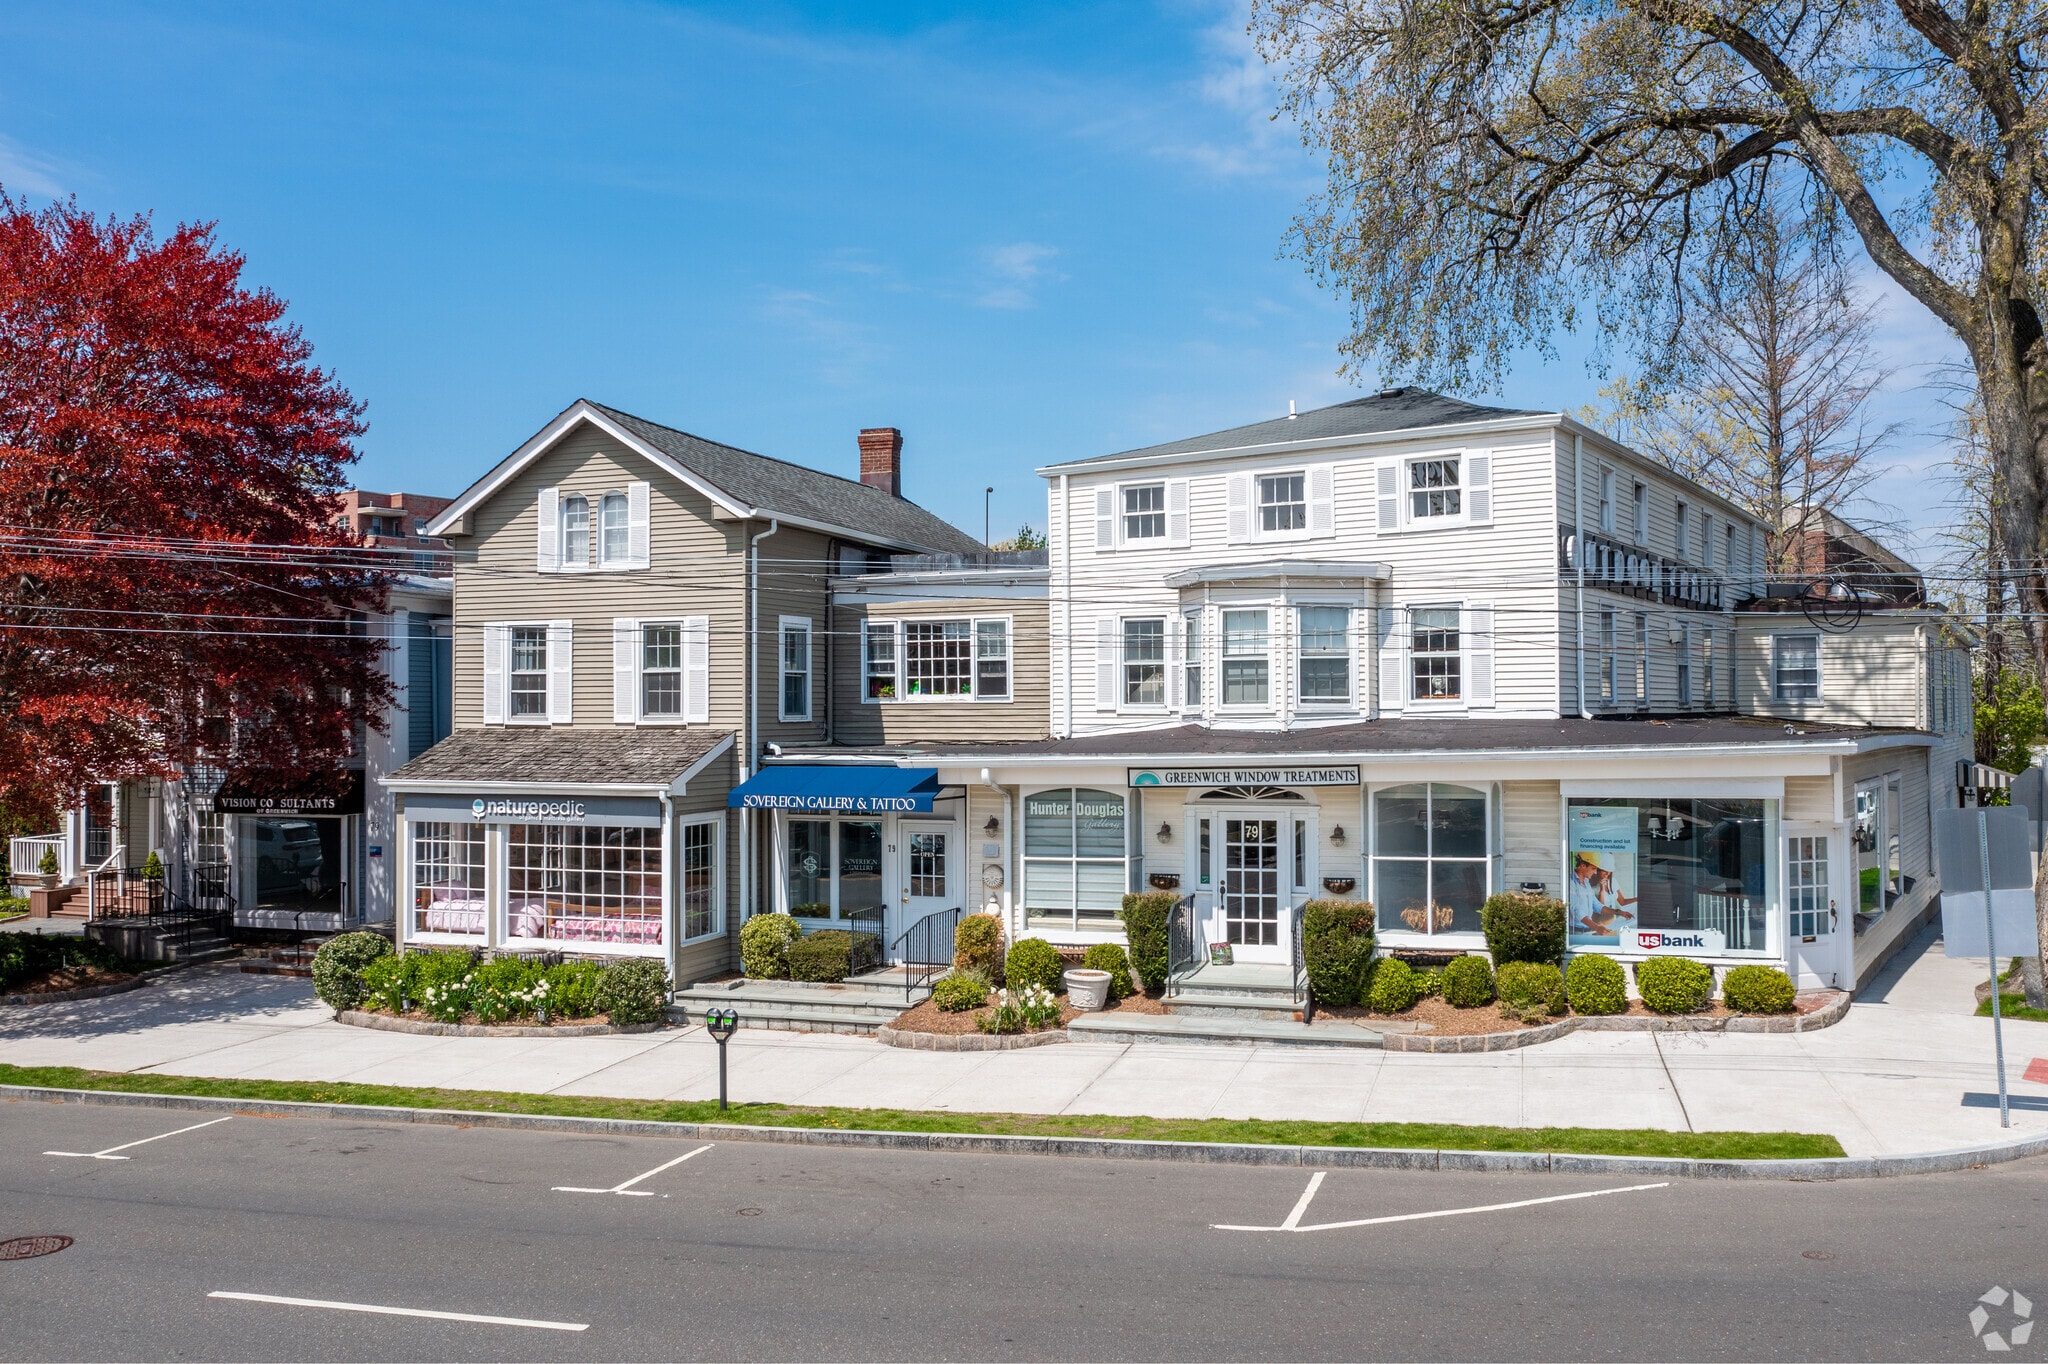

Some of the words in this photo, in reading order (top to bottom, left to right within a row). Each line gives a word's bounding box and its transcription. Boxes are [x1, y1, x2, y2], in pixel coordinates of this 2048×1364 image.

[1165, 771, 1231, 784] GREENWICH
[1234, 770, 1281, 783] WINDOW
[1284, 769, 1356, 782] TREATMENTS
[221, 798, 257, 808] VISION
[487, 799, 586, 821] naturepedic
[743, 794, 805, 808] SOVEREIGN
[807, 796, 854, 809] GALLERY
[857, 798, 867, 809] &
[870, 797, 916, 811] TATTOO
[1029, 801, 1070, 816] Hunter
[1076, 802, 1124, 818] Douglas
[1244, 825, 1259, 839] 79
